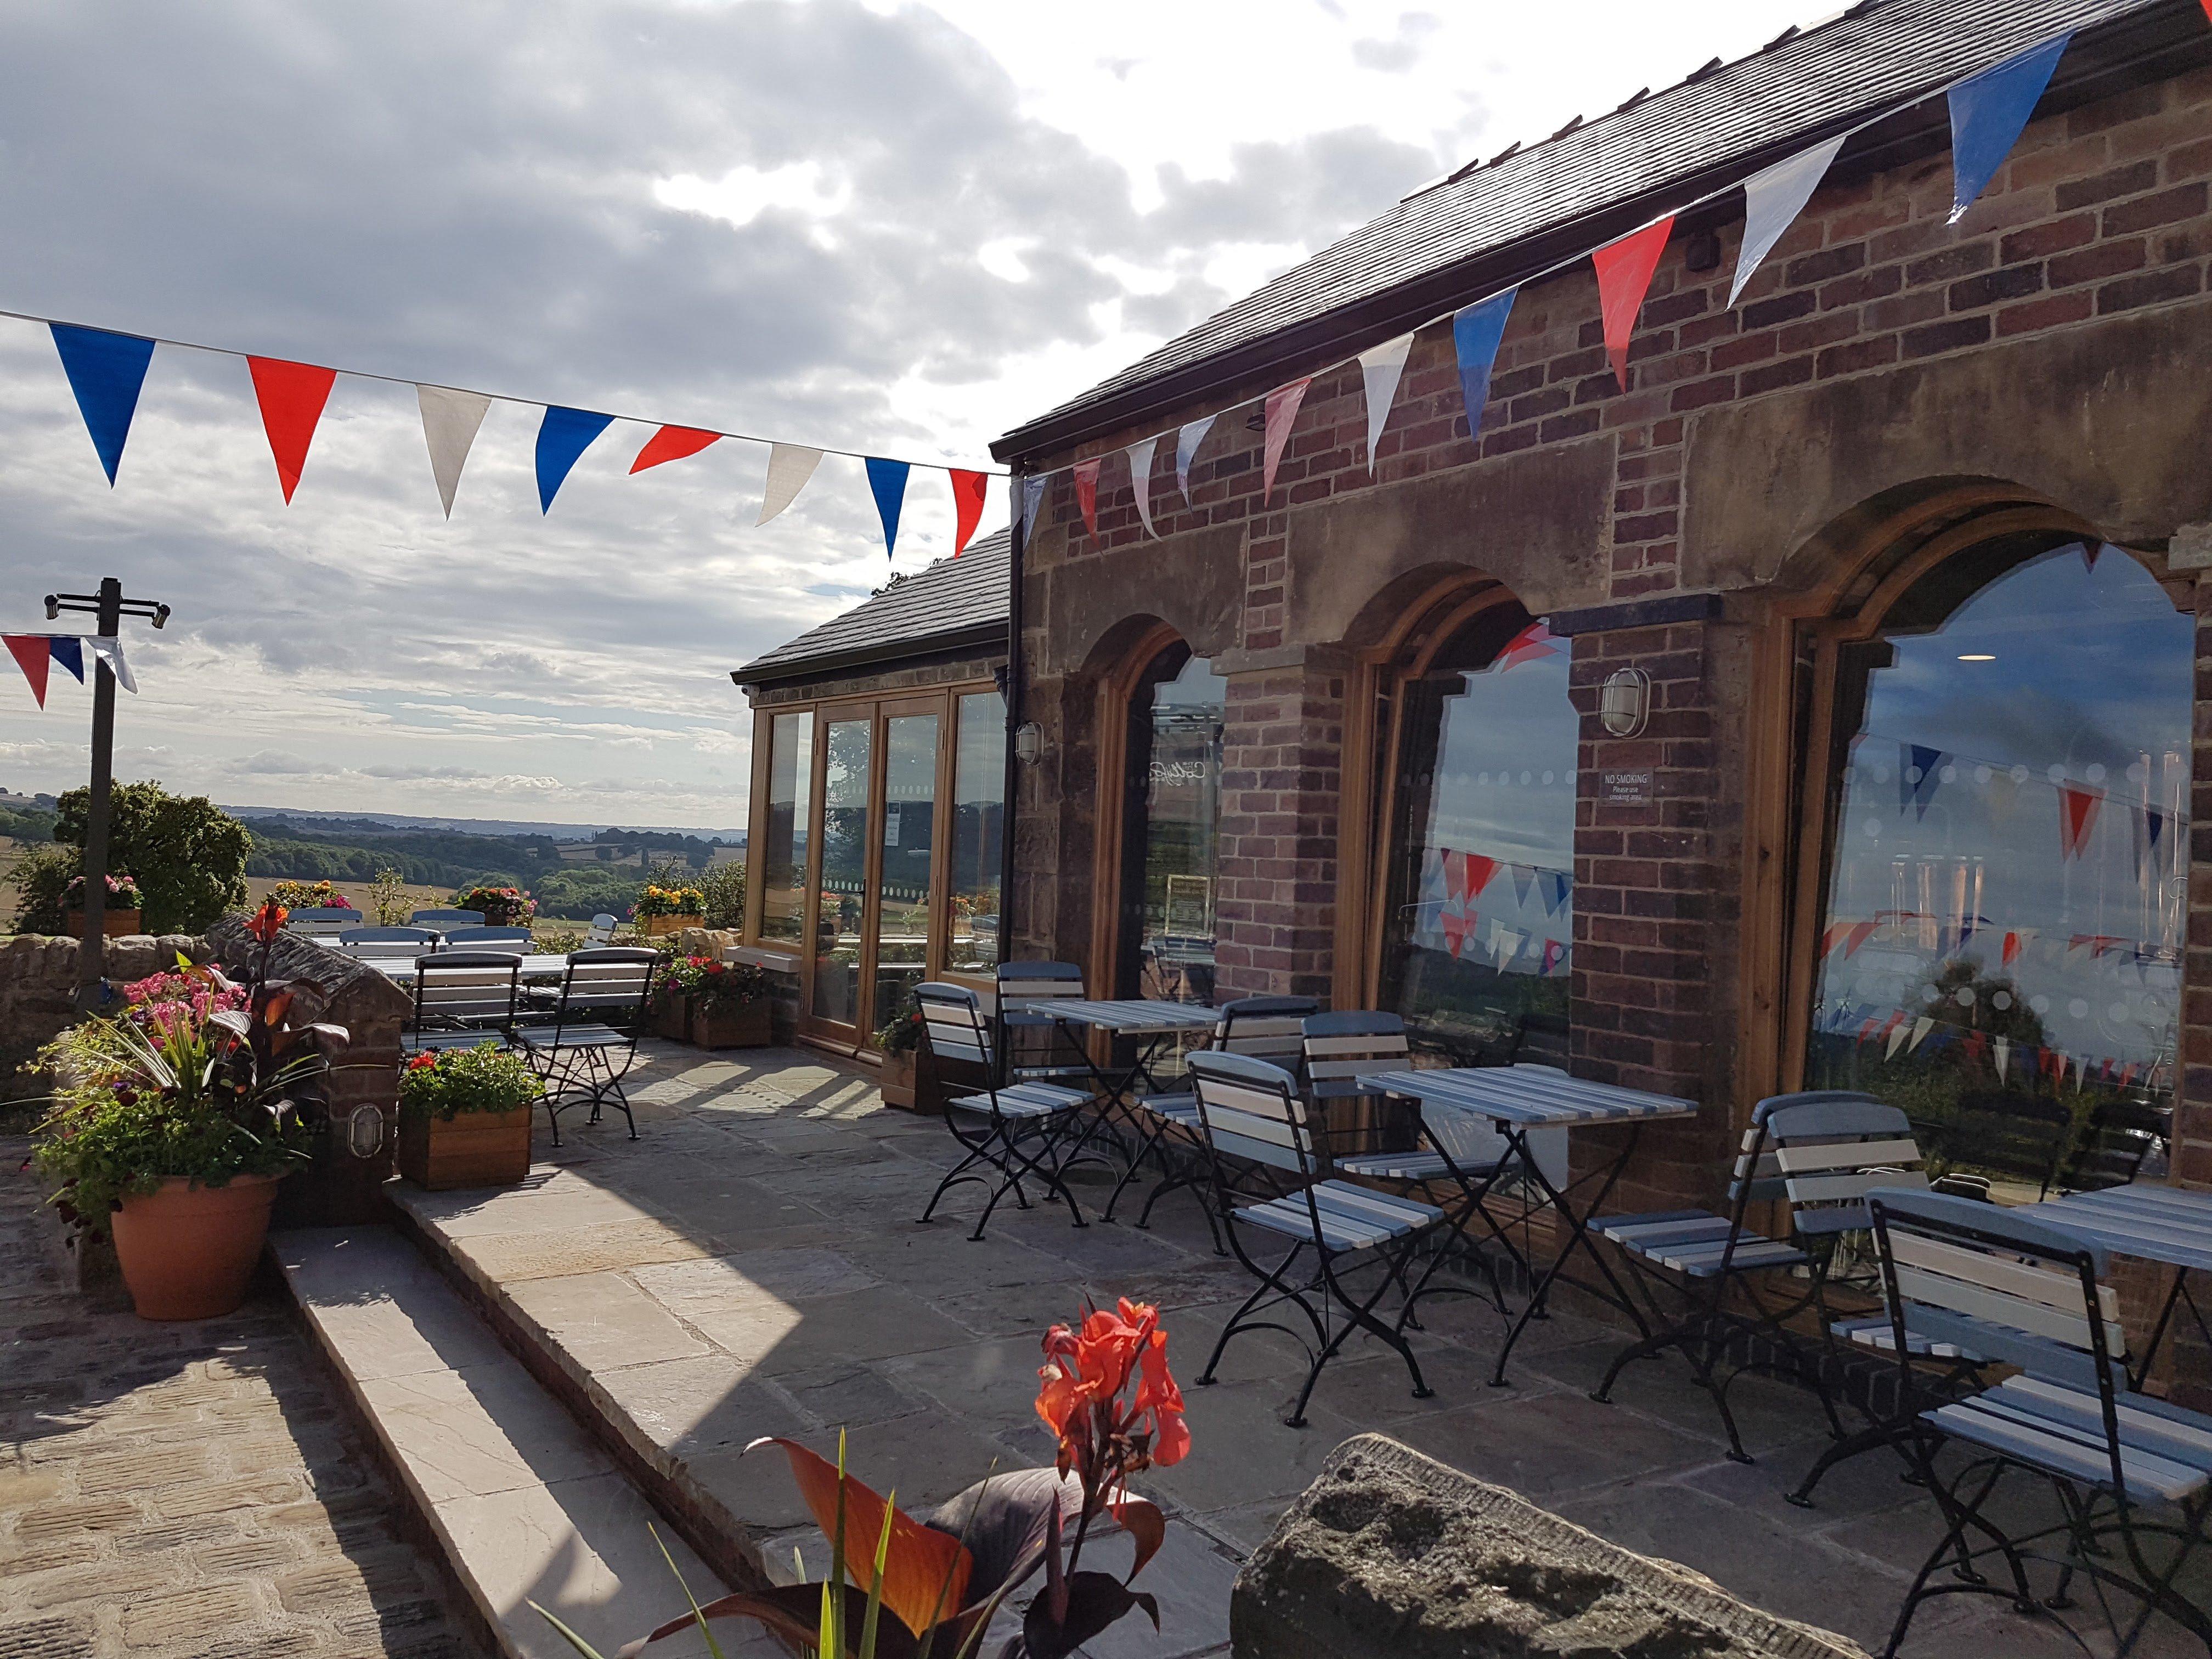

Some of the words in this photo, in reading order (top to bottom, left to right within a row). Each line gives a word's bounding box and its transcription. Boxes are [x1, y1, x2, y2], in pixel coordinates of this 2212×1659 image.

[1605, 775, 1615, 783] NO
[1617, 774, 1647, 783] SMOKING
[1609, 794, 1629, 802] smoking
